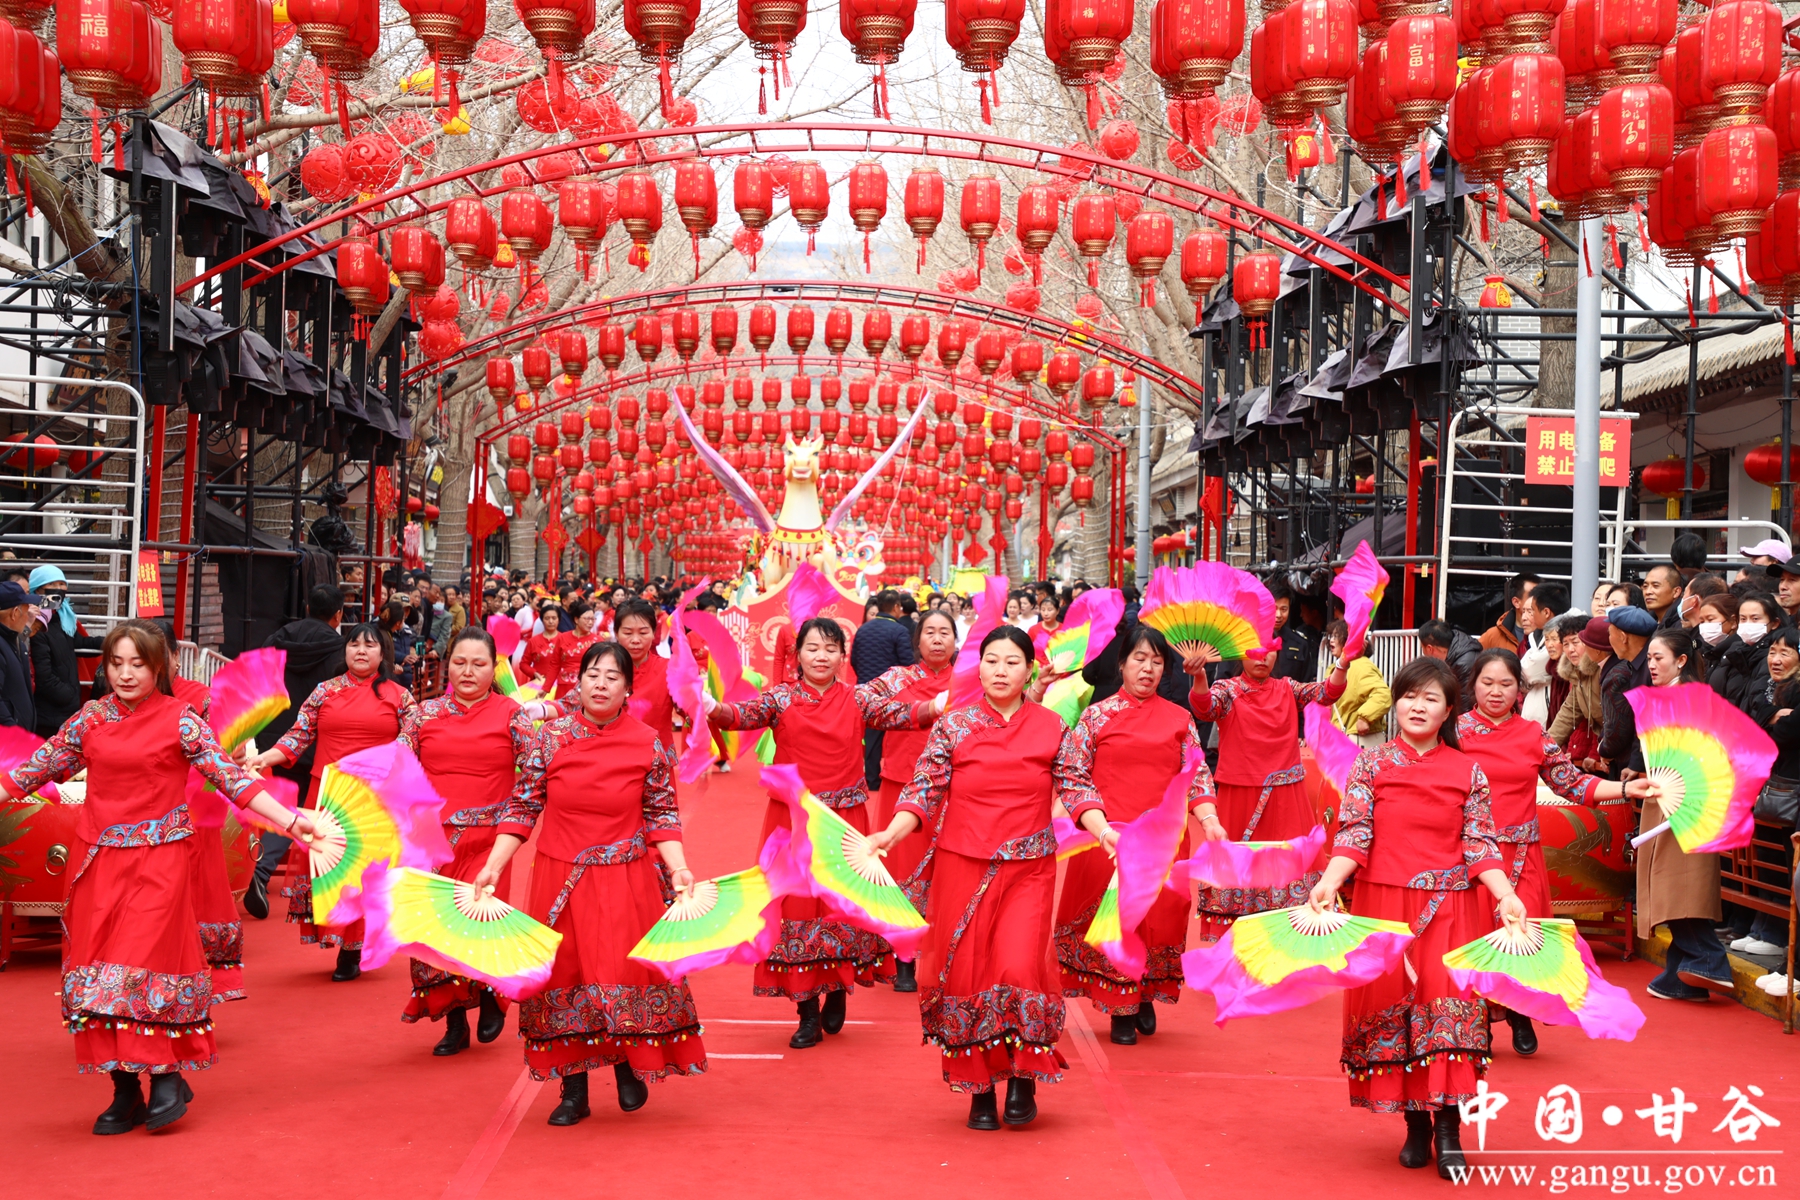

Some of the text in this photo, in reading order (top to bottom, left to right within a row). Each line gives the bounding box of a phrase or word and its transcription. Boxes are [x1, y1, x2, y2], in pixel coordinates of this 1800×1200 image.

[81, 13, 109, 37] 福
[1538, 430, 1617, 452] 用电备
[1537, 454, 1616, 477] 禁止爬
